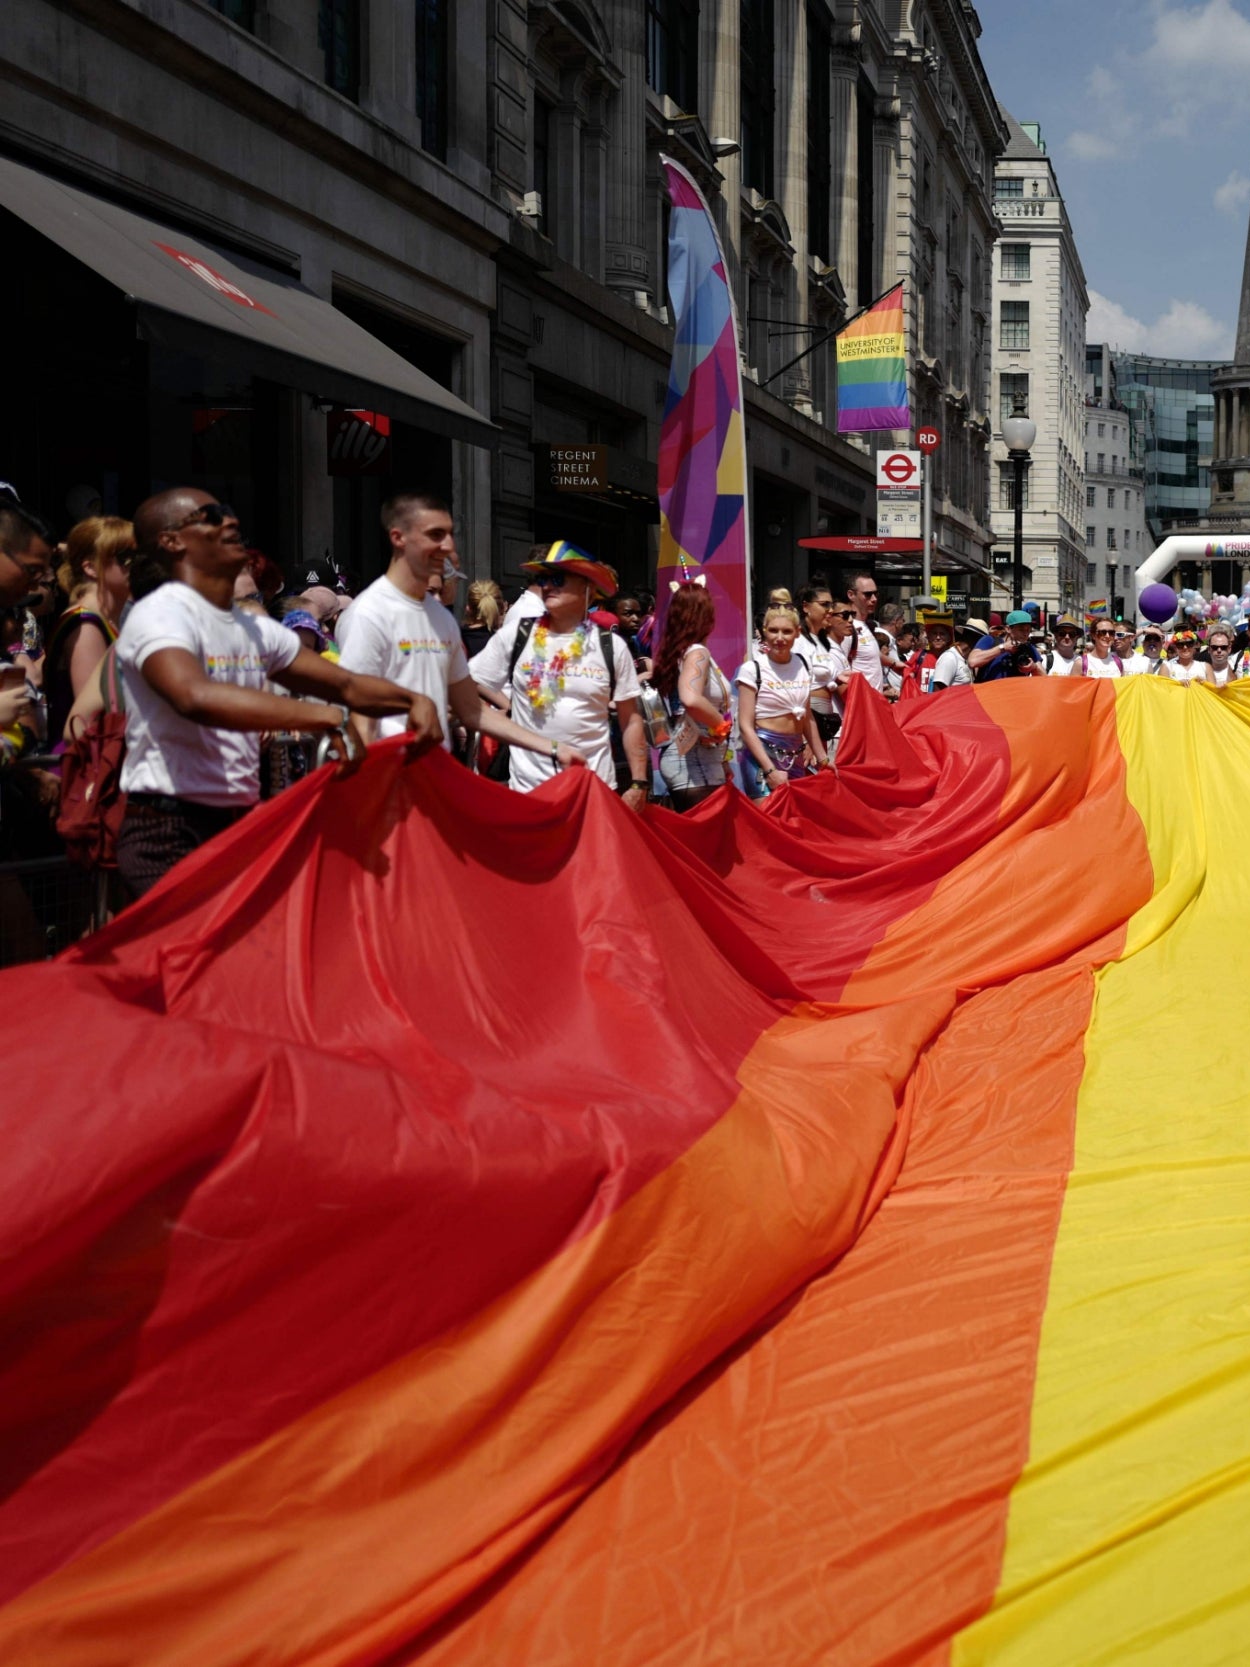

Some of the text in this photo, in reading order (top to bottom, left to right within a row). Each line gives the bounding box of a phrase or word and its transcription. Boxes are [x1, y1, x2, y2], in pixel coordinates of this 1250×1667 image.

[178, 255, 254, 306] illy
[840, 338, 883, 350] UNIVERSITY
[840, 345, 896, 357] WESTMINSTER
[331, 420, 387, 469] illy
[920, 434, 937, 444] RD
[549, 451, 597, 461] REGENT
[550, 464, 590, 473] STREET
[550, 476, 599, 486] CINEMA
